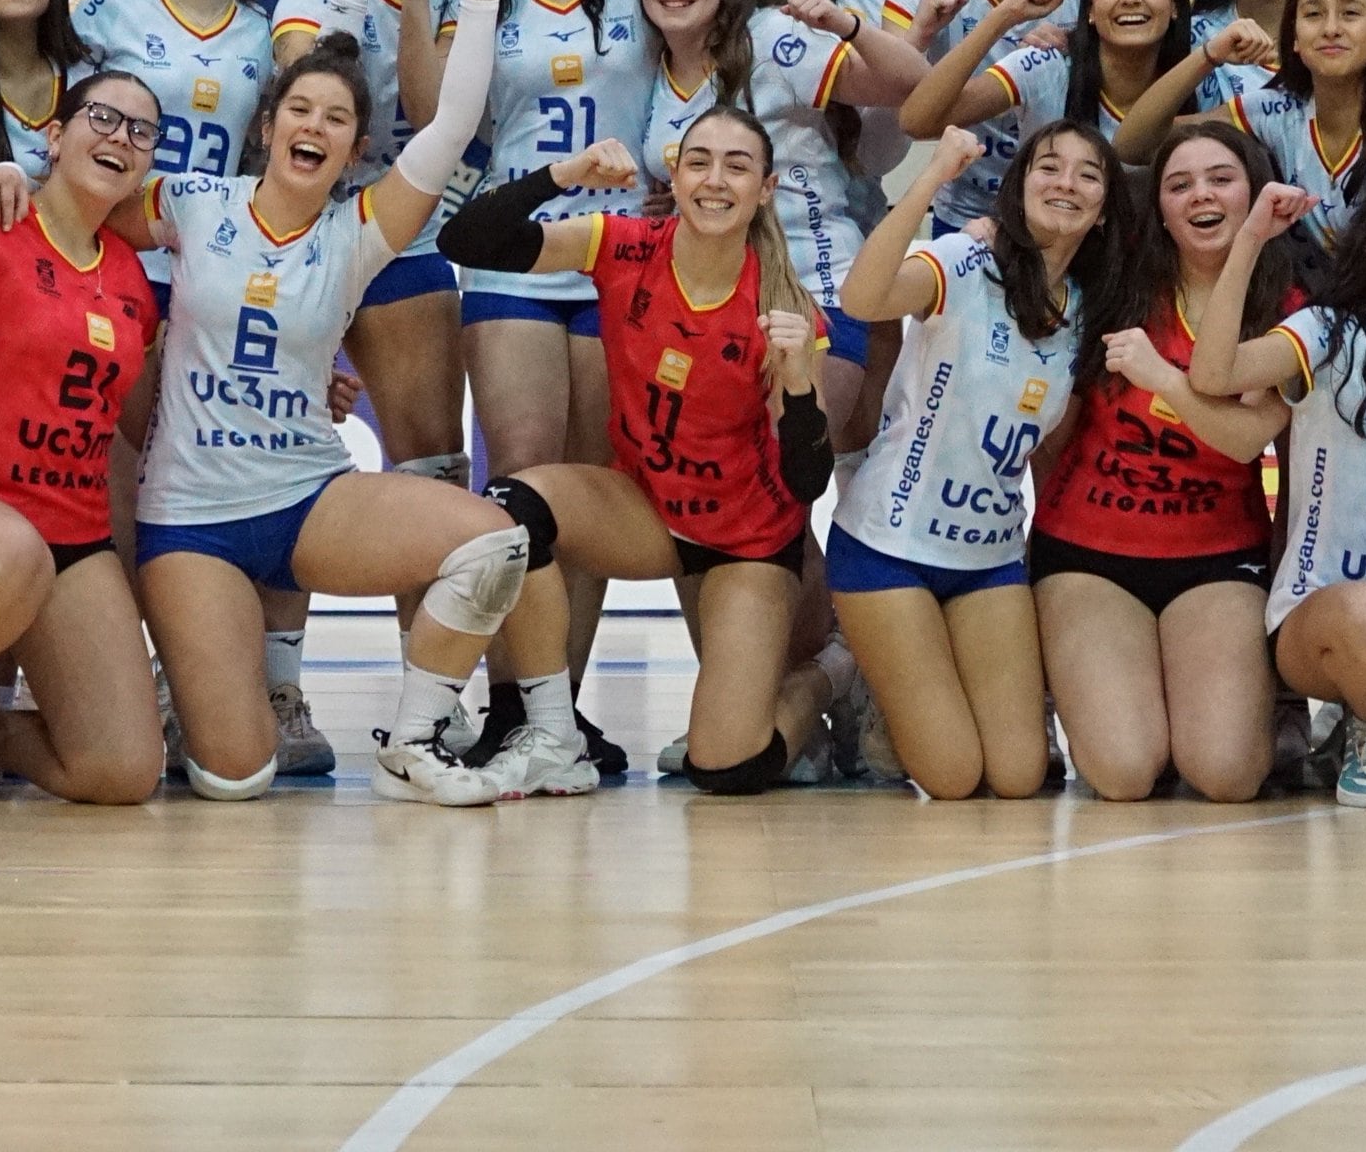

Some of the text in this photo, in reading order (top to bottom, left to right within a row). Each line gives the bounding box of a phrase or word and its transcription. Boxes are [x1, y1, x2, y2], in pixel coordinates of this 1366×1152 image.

[152, 113, 230, 179] 93
[536, 96, 596, 153] 31
[232, 305, 280, 370] 6
[189, 371, 309, 419] uc3m
[889, 360, 954, 529] cvleganes.com
